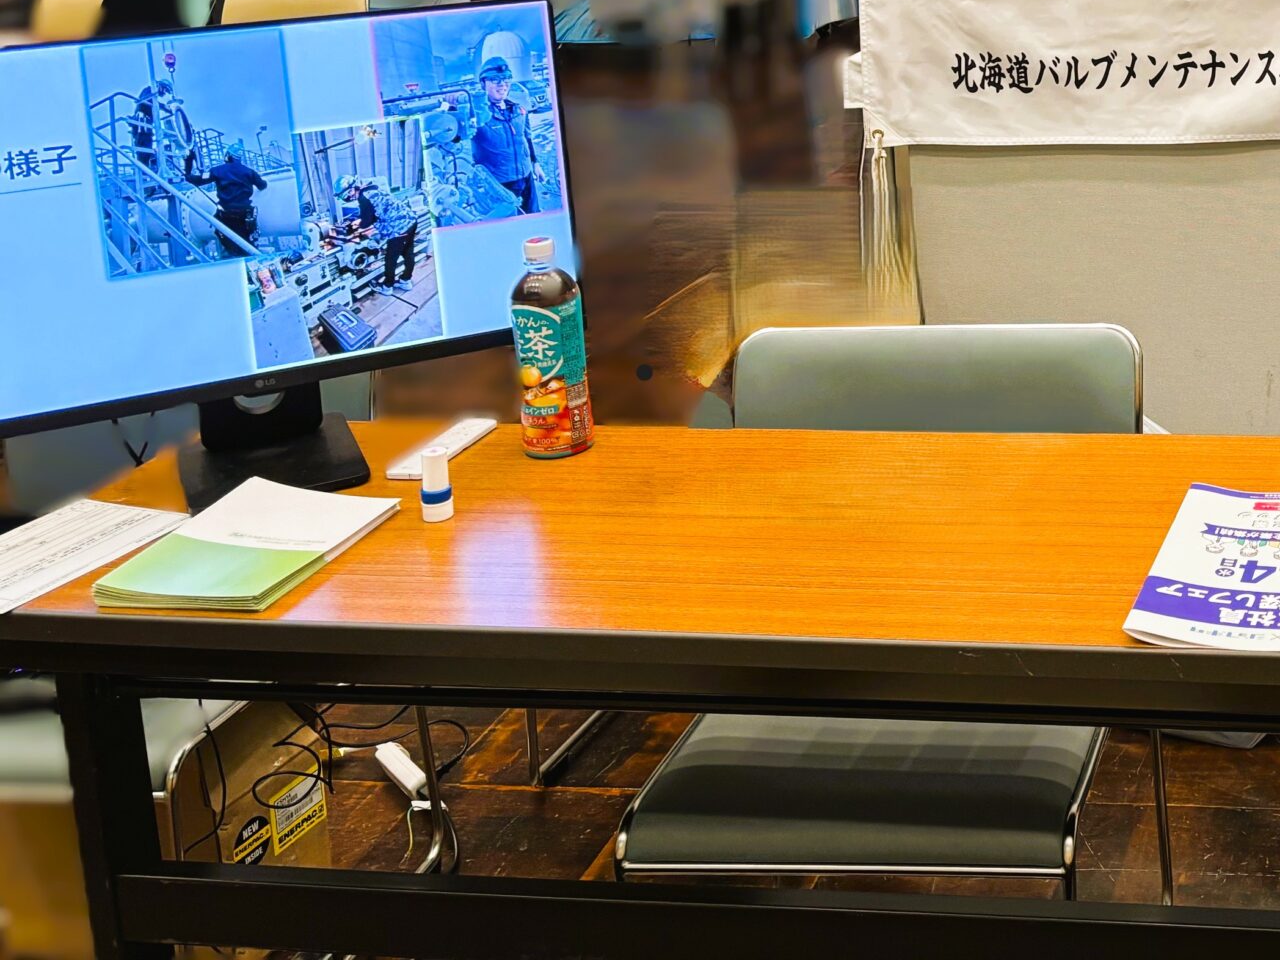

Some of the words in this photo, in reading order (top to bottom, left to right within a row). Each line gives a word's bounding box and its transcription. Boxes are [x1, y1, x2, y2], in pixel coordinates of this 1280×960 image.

[0, 145, 77, 180] 様子
[242, 819, 259, 841] NEW
[278, 809, 318, 845] ENERPAC
[244, 845, 264, 865] INSIDE
